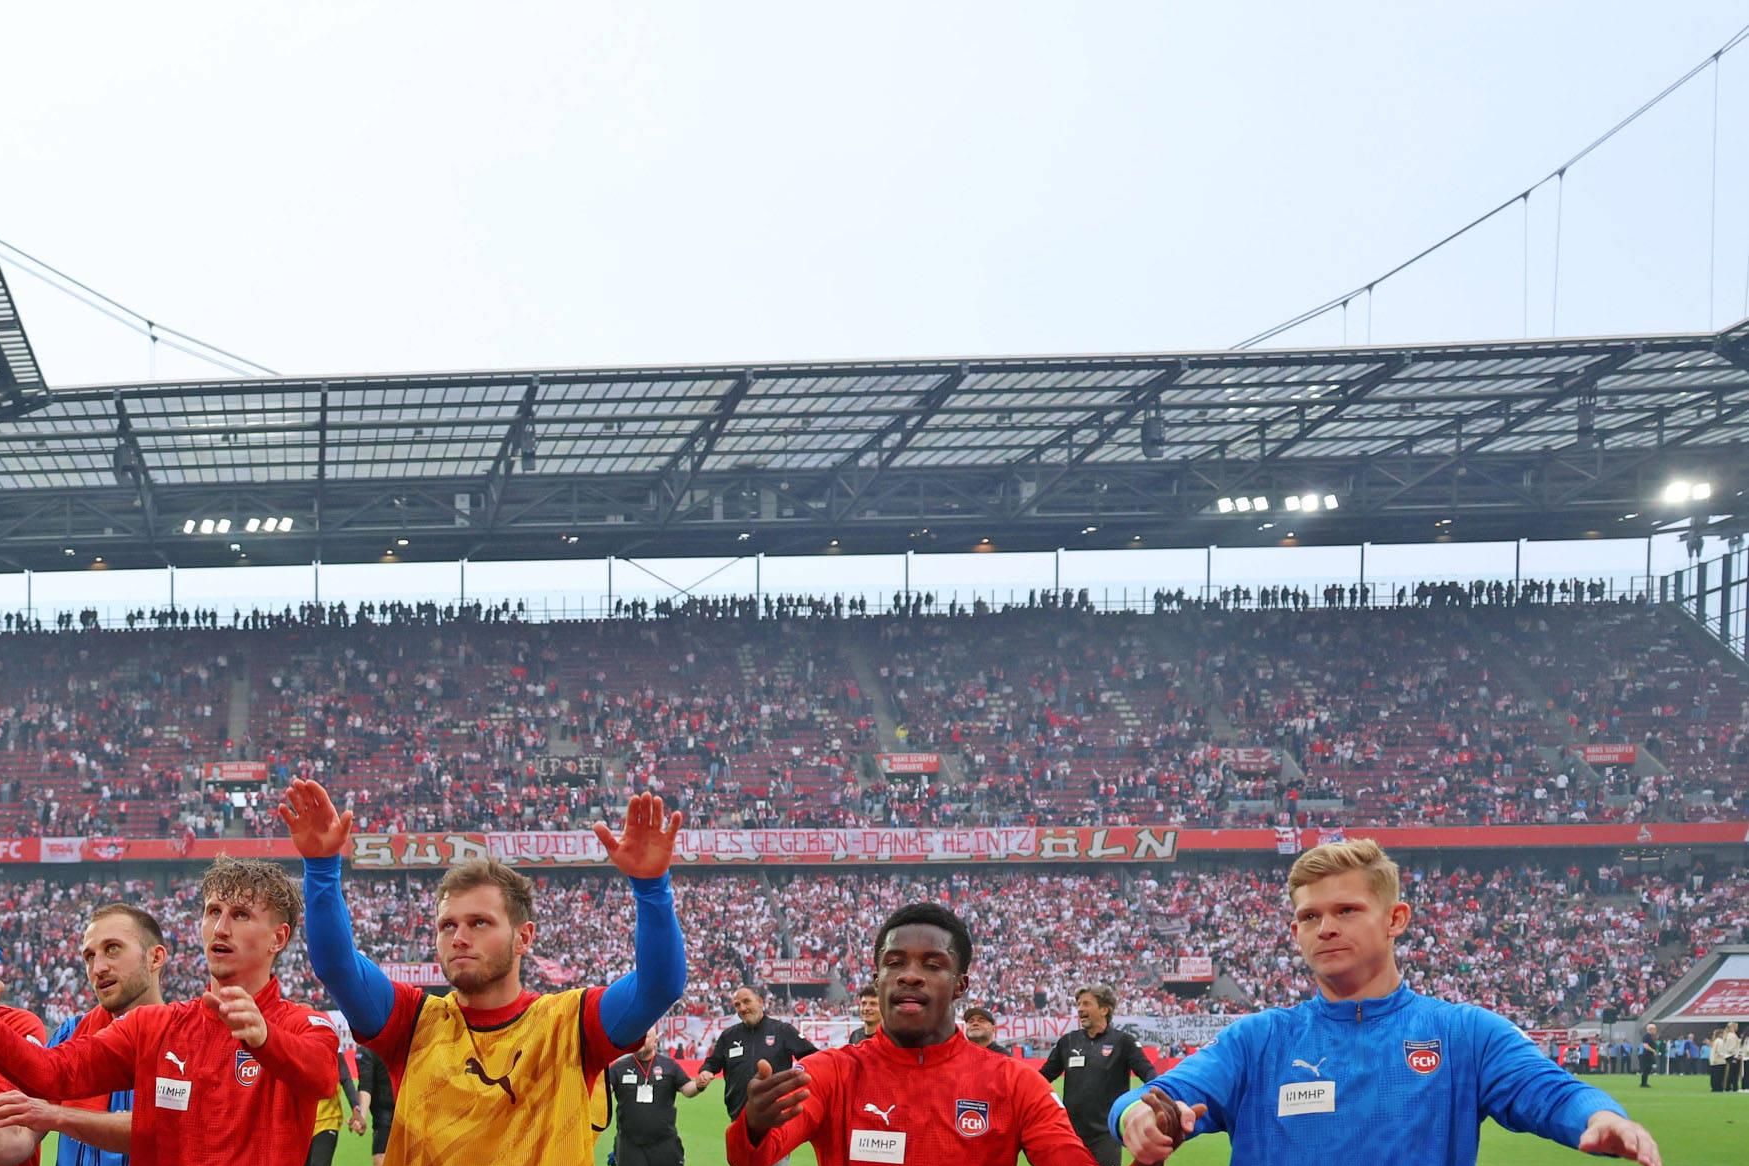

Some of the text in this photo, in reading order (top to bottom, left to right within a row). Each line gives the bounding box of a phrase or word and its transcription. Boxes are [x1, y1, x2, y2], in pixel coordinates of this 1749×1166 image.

[535, 835, 577, 855] DIE
[674, 832, 743, 853] ALLES
[751, 832, 848, 853] GEGEBEN
[943, 830, 1031, 854] HEINTZ
[1039, 829, 1177, 859] ÖLN
[994, 1016, 1070, 1039] KAINZ
[1412, 1056, 1436, 1067] FCH
[241, 1065, 259, 1078] FCH
[166, 1086, 187, 1098] MHP
[1297, 1088, 1325, 1099] MHP
[961, 1117, 982, 1130] FCH
[871, 1138, 897, 1150] MHP
